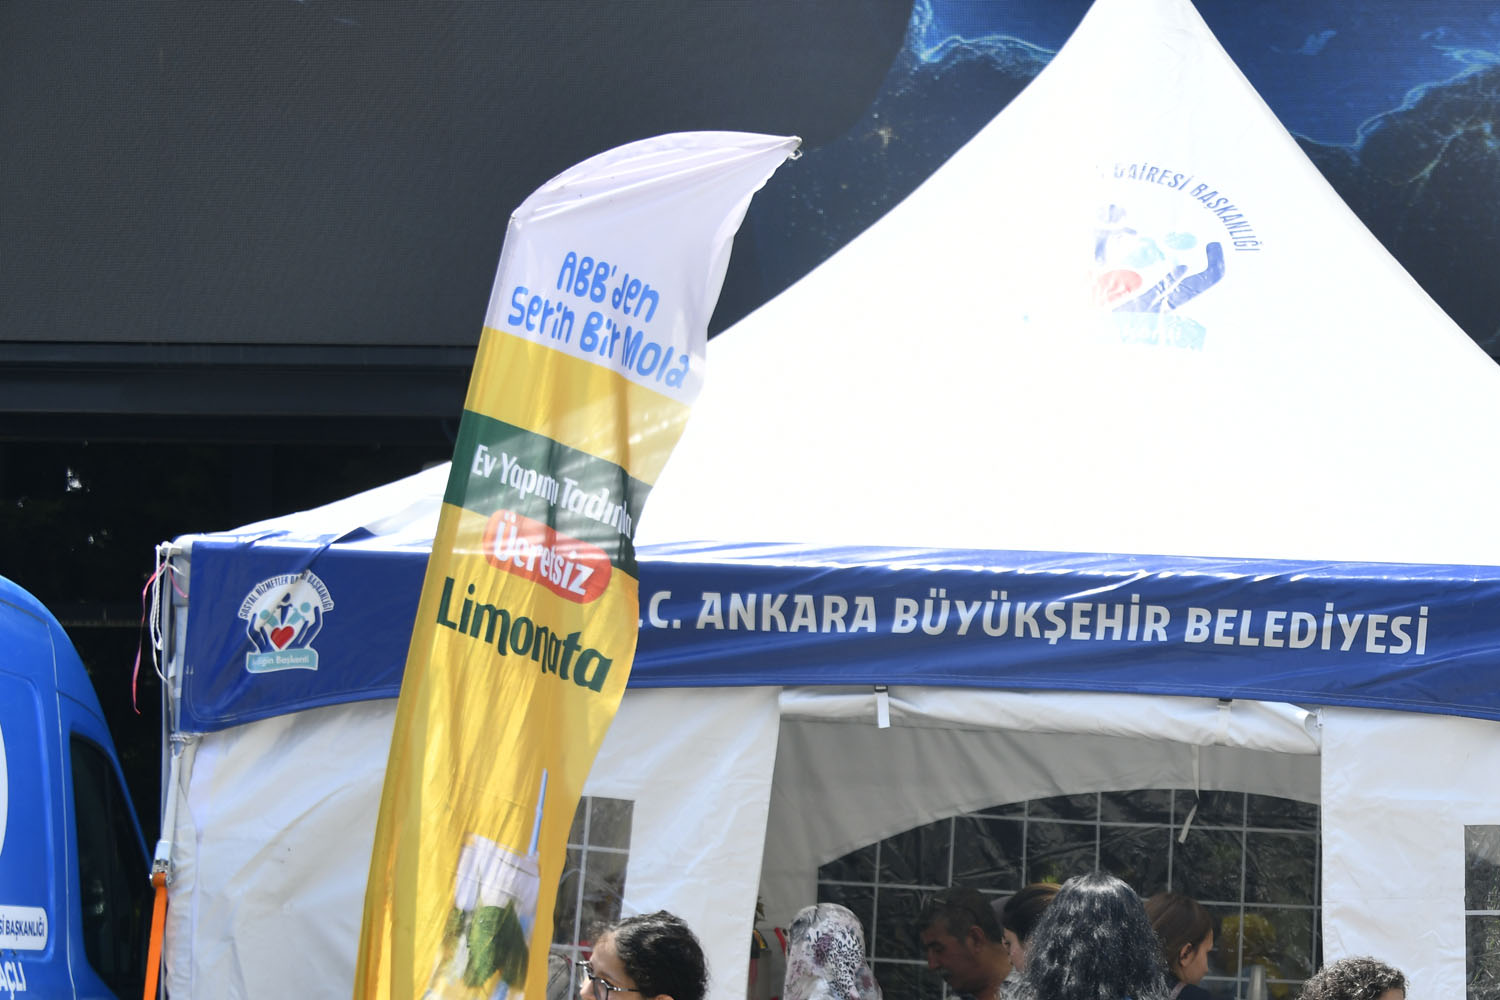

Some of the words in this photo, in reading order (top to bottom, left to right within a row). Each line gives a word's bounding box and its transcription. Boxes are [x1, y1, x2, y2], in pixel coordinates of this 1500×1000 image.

[557, 251, 660, 323] ABB'den
[508, 286, 575, 344] Serin
[579, 311, 621, 359] Bir
[472, 443, 497, 478] Ev
[500, 452, 560, 507] Yapımı
[494, 511, 595, 596] Ücretsiz
[240, 594, 258, 618] SOSYAL
[436, 576, 613, 694] Limonata
[638, 590, 681, 629] .C.
[696, 591, 877, 634] ANKARA
[891, 587, 1171, 645] BÜYÜKŞEHİR
[1184, 602, 1429, 656] BELEDİYESİ
[5, 916, 45, 941] BAŞKANLIĞI
